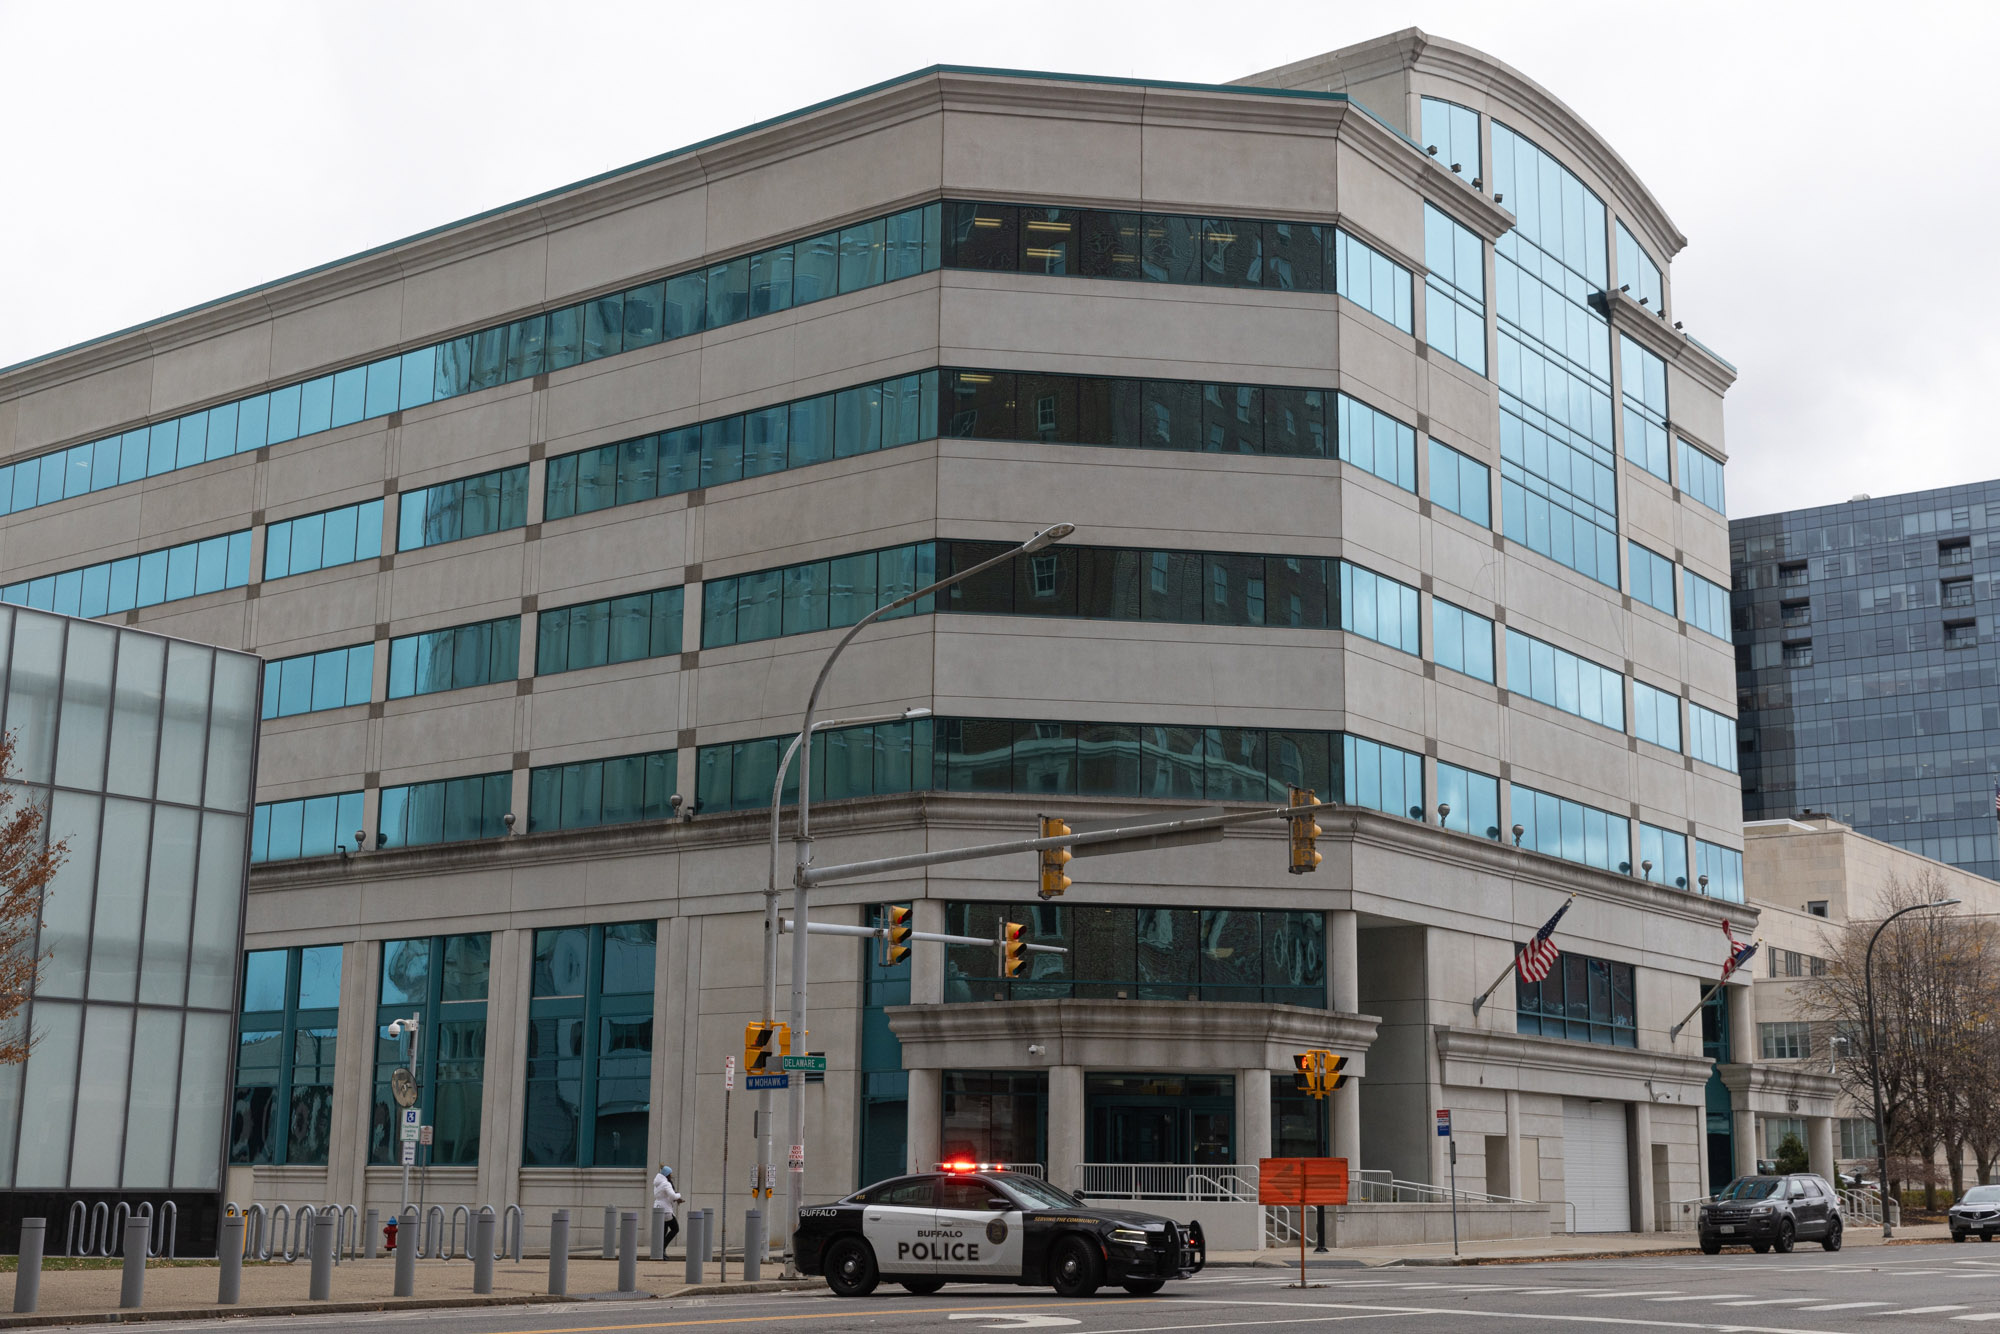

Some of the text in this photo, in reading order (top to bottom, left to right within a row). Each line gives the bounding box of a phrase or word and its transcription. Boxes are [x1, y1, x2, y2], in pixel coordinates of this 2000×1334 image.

[784, 1058, 816, 1068] DELAWARE
[748, 1078, 754, 1087] W
[754, 1076, 782, 1087] MOHAWK
[800, 1209, 837, 1217] BUFFALO
[917, 1230, 963, 1238] BUFFALO
[898, 1242, 979, 1261] POLICE
